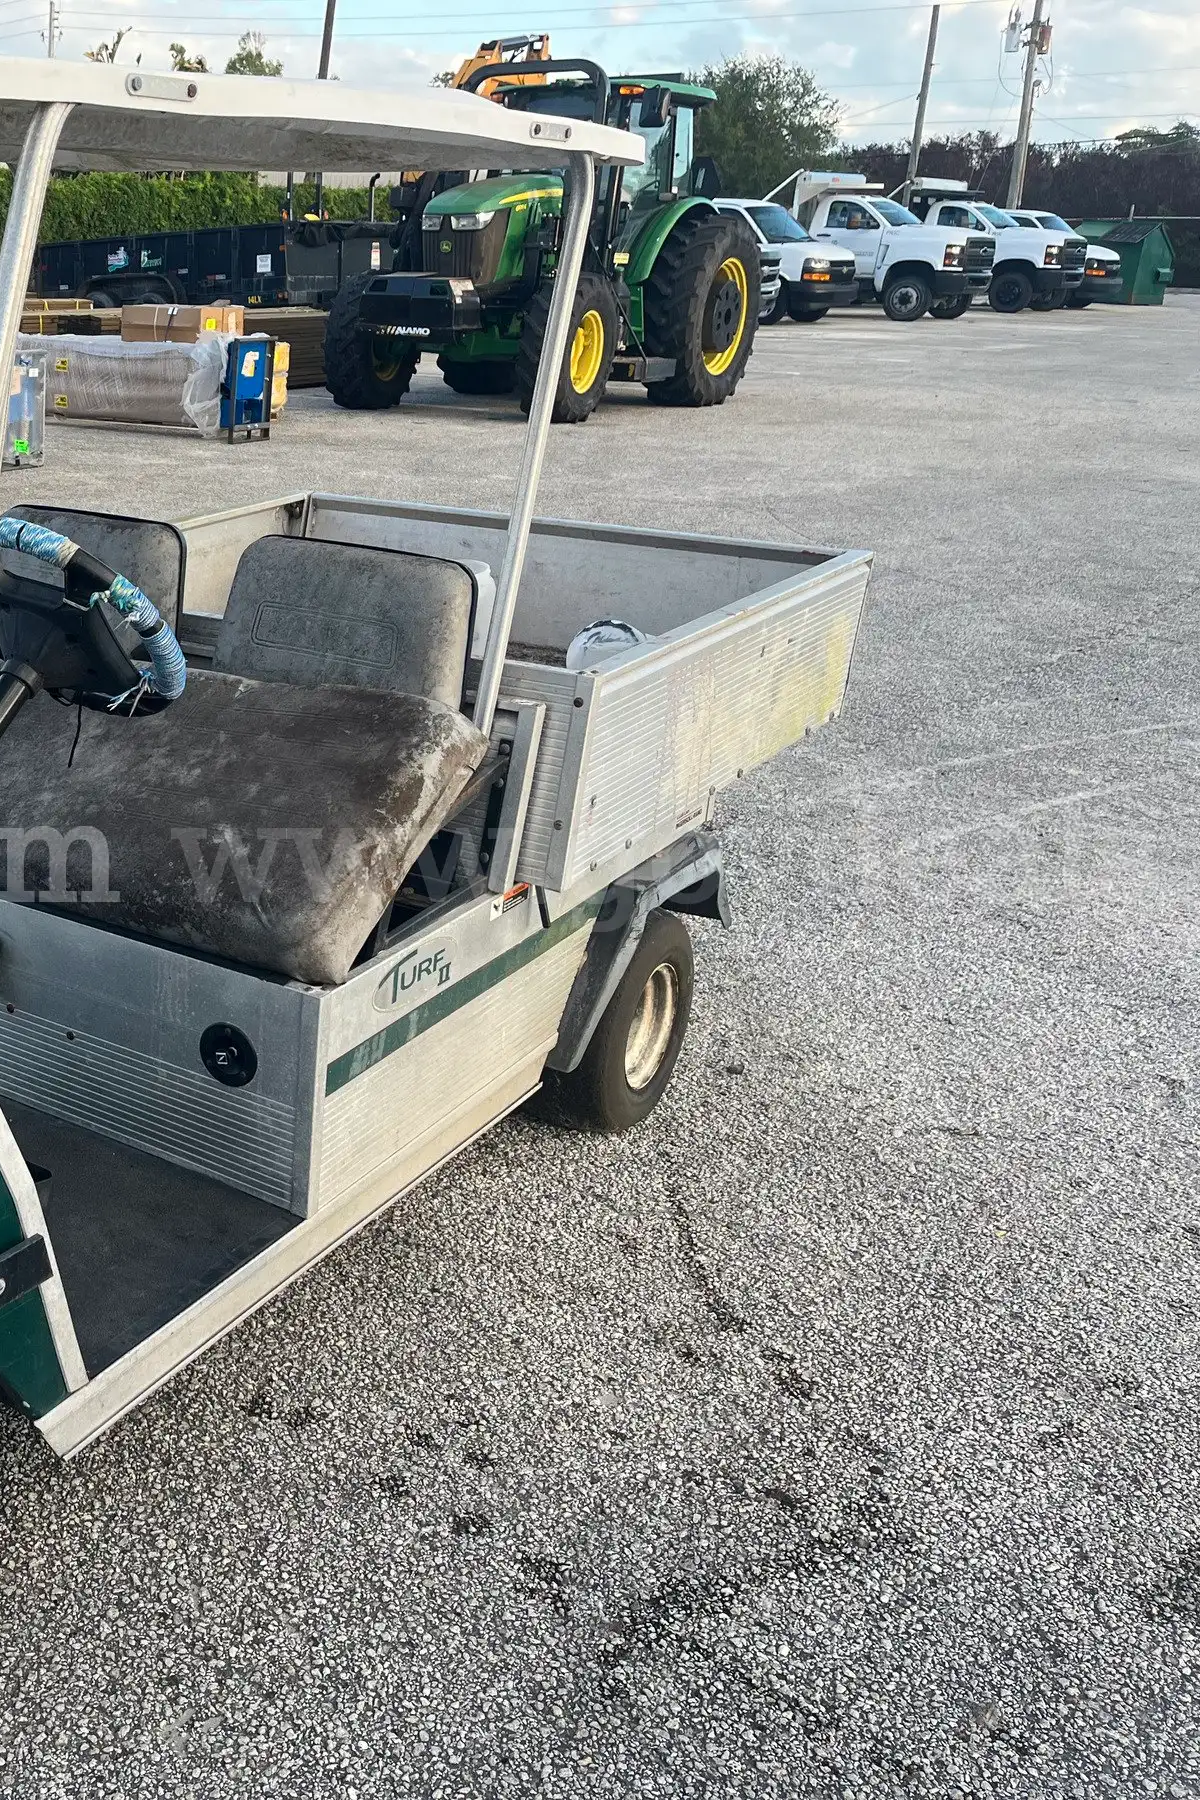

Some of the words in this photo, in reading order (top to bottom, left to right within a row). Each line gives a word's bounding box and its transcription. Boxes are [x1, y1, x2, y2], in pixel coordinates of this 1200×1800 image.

[394, 326, 431, 336] ALAMO
[378, 948, 446, 1004] TURF
[437, 962, 452, 987] II
